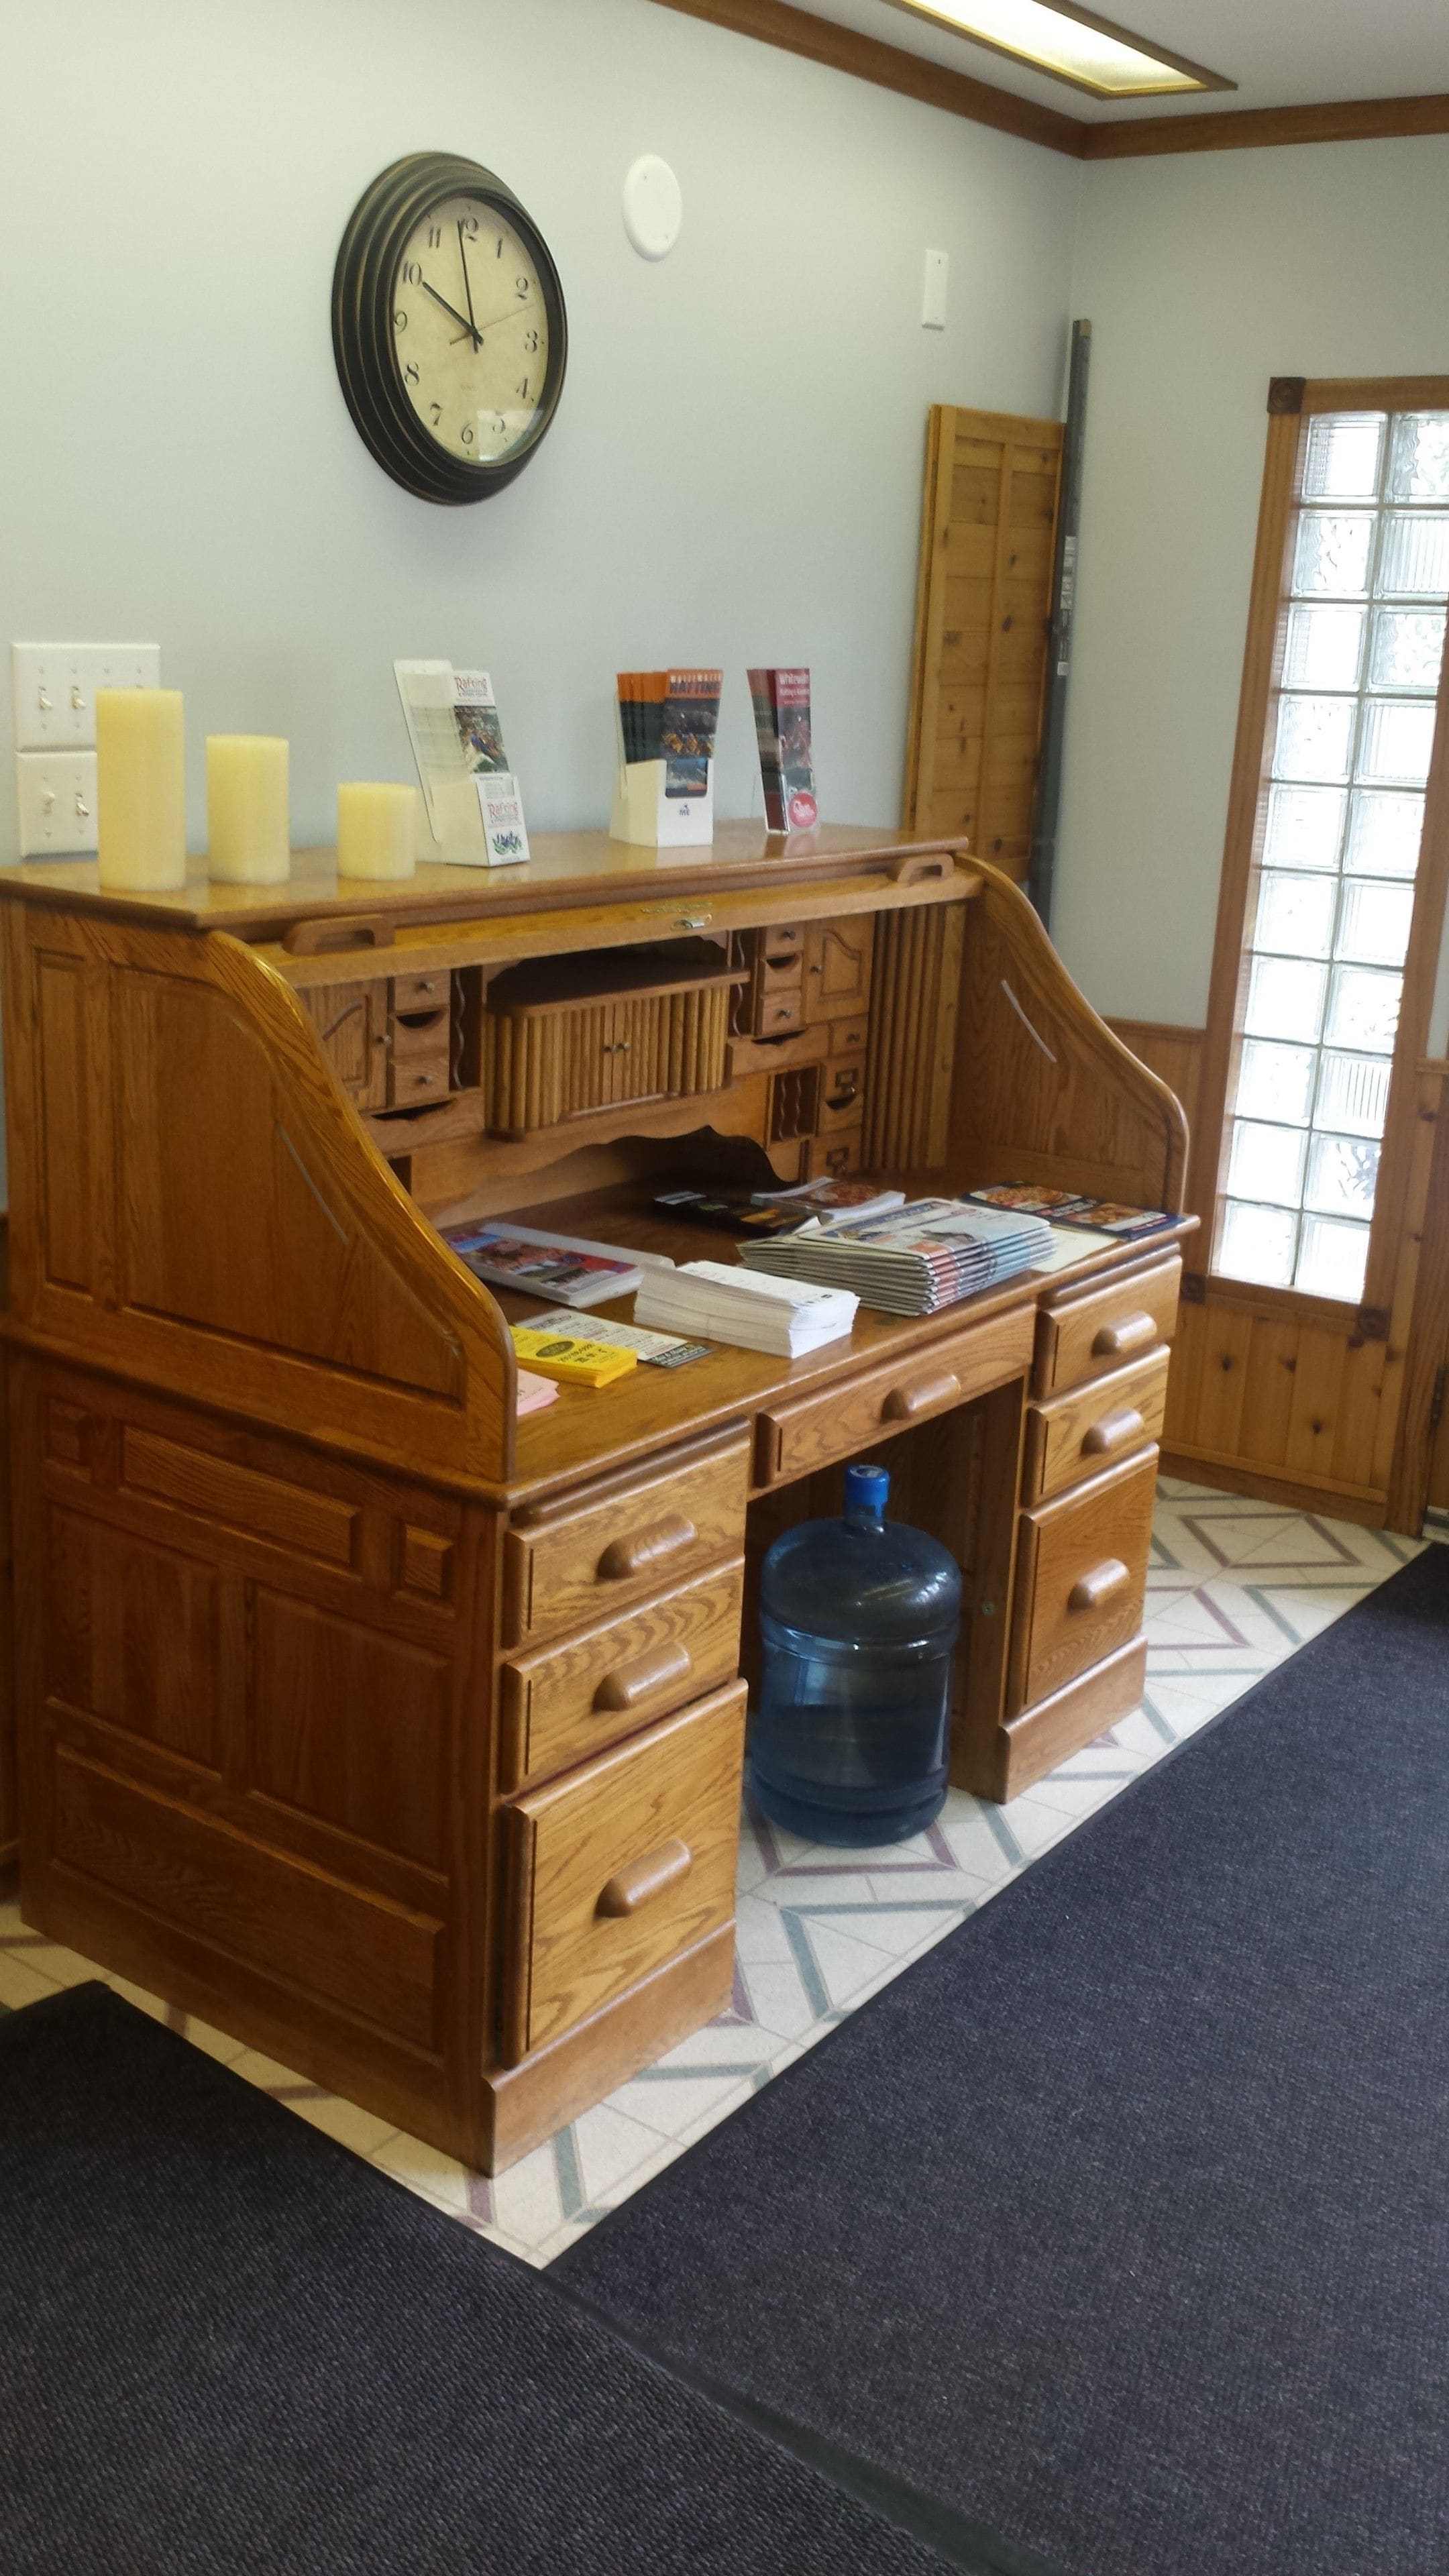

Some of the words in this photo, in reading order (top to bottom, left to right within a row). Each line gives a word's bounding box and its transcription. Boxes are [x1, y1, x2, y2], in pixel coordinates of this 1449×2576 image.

[428, 227, 441, 249] 11
[496, 237, 503, 260] 1
[403, 261, 423, 285] 10
[515, 276, 529, 300] 2
[394, 311, 408, 334] 9
[525, 329, 539, 353] 3
[405, 362, 420, 386] 8
[516, 378, 529, 400] 4
[430, 402, 443, 427] 7
[492, 410, 506, 434] 5
[462, 423, 474, 445] 6
